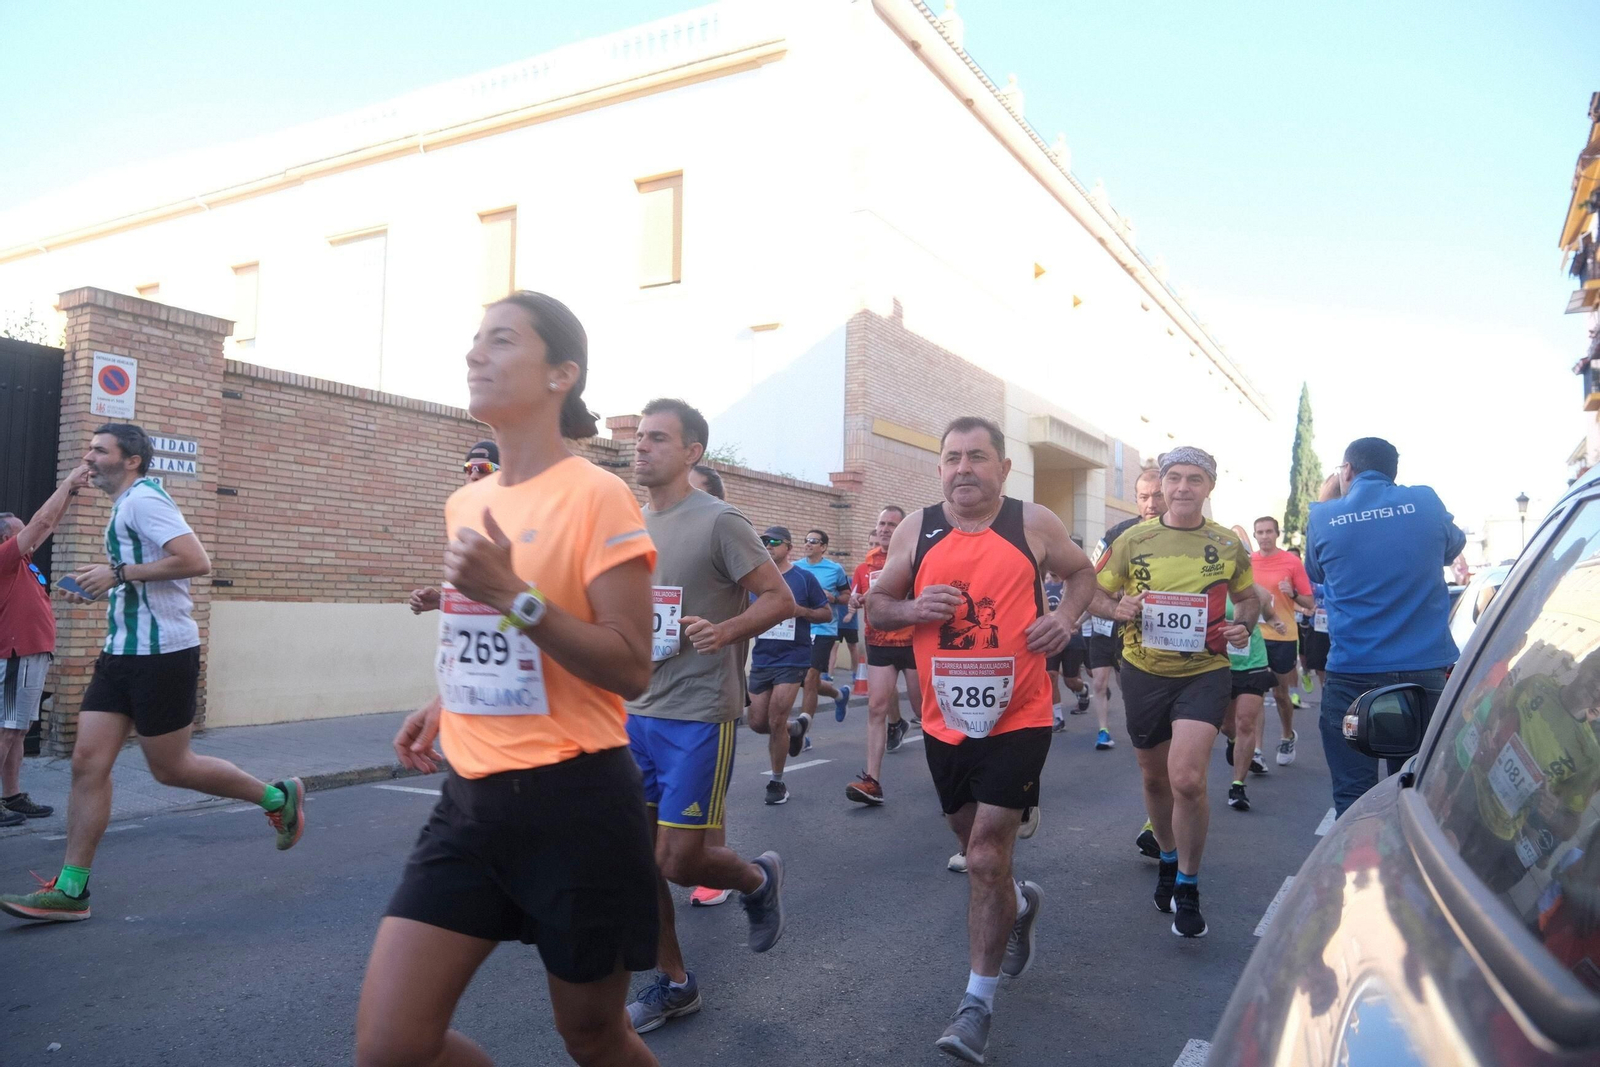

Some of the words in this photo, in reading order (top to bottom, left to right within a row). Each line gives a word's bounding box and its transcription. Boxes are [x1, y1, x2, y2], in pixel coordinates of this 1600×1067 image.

[149, 437, 195, 453] NIDAD
[149, 457, 194, 472] SIANA
[652, 590, 678, 598] UXILIADORA
[1157, 612, 1192, 629] 180
[458, 630, 510, 666] 269
[951, 686, 996, 708] 286
